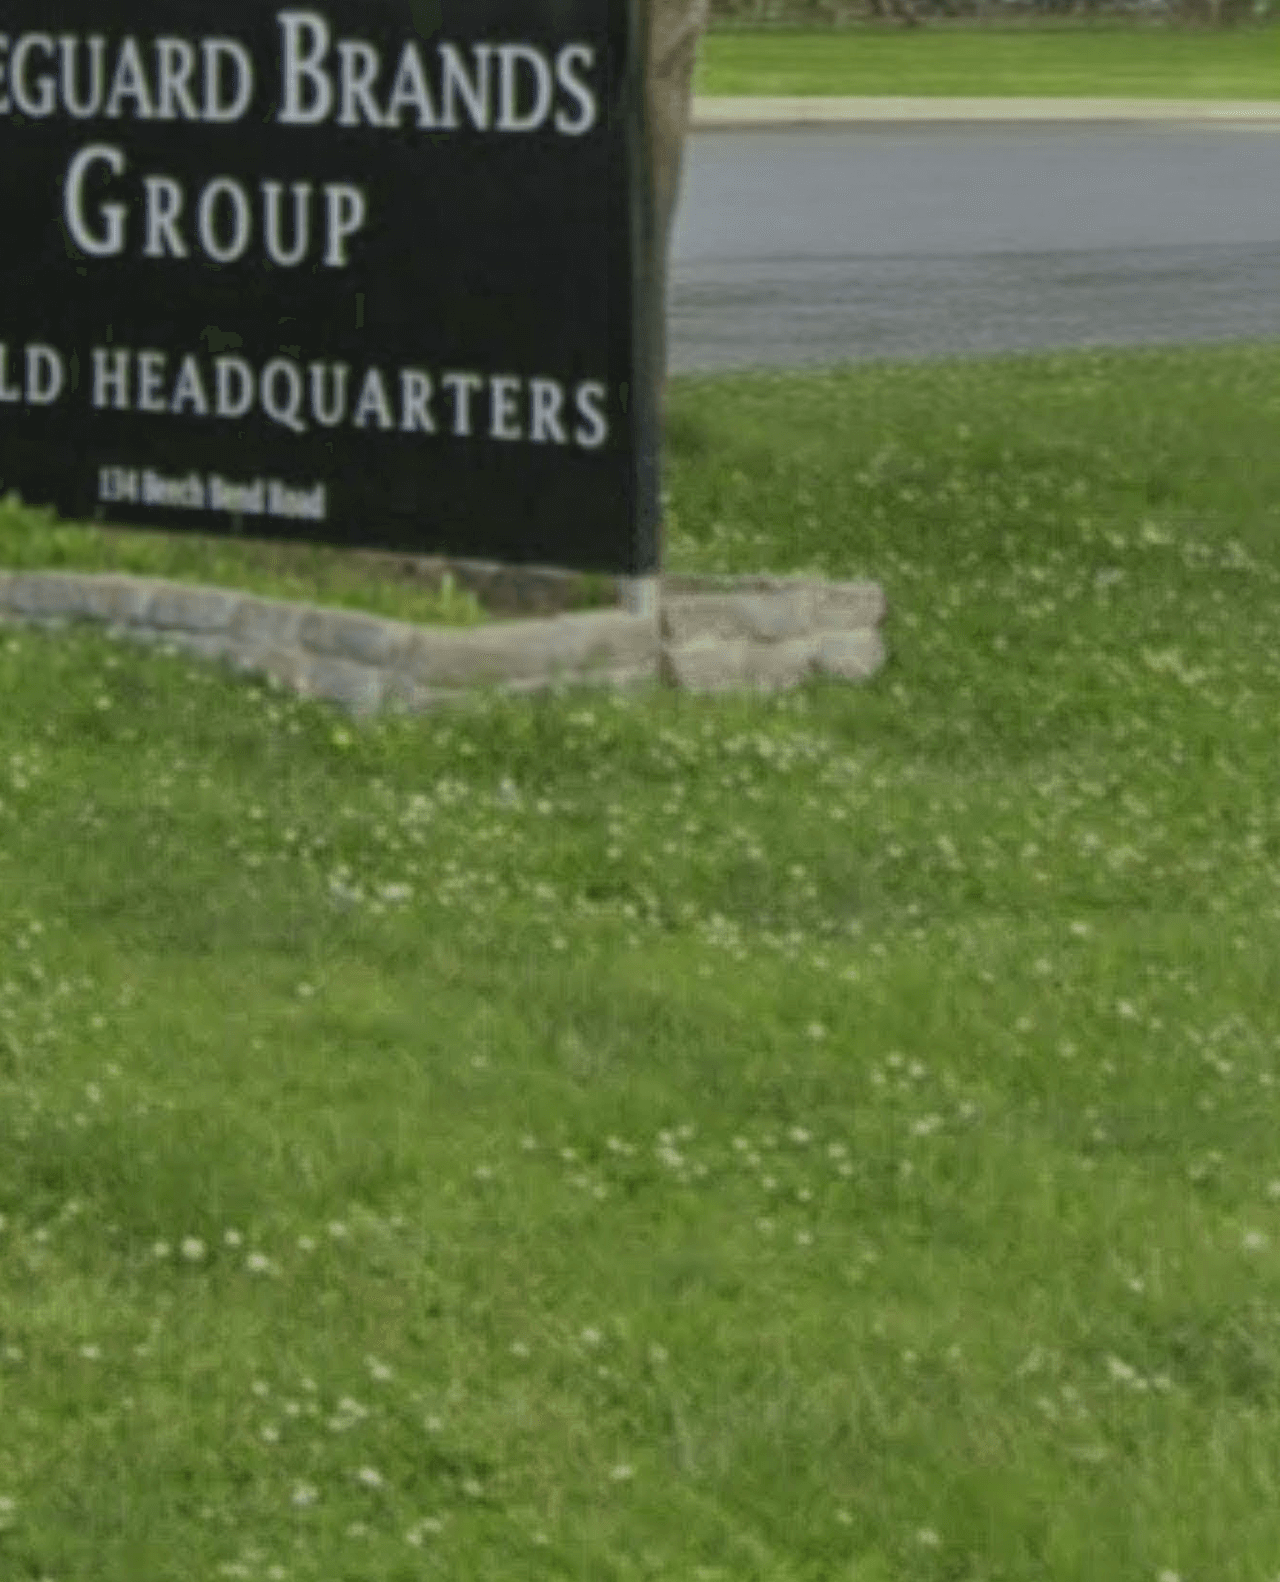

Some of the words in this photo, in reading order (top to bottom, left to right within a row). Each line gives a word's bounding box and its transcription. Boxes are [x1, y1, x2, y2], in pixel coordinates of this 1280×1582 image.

[277, 9, 598, 136] BRANDS
[63, 143, 366, 267] GROUP
[93, 348, 608, 449] HEADQUARTERS
